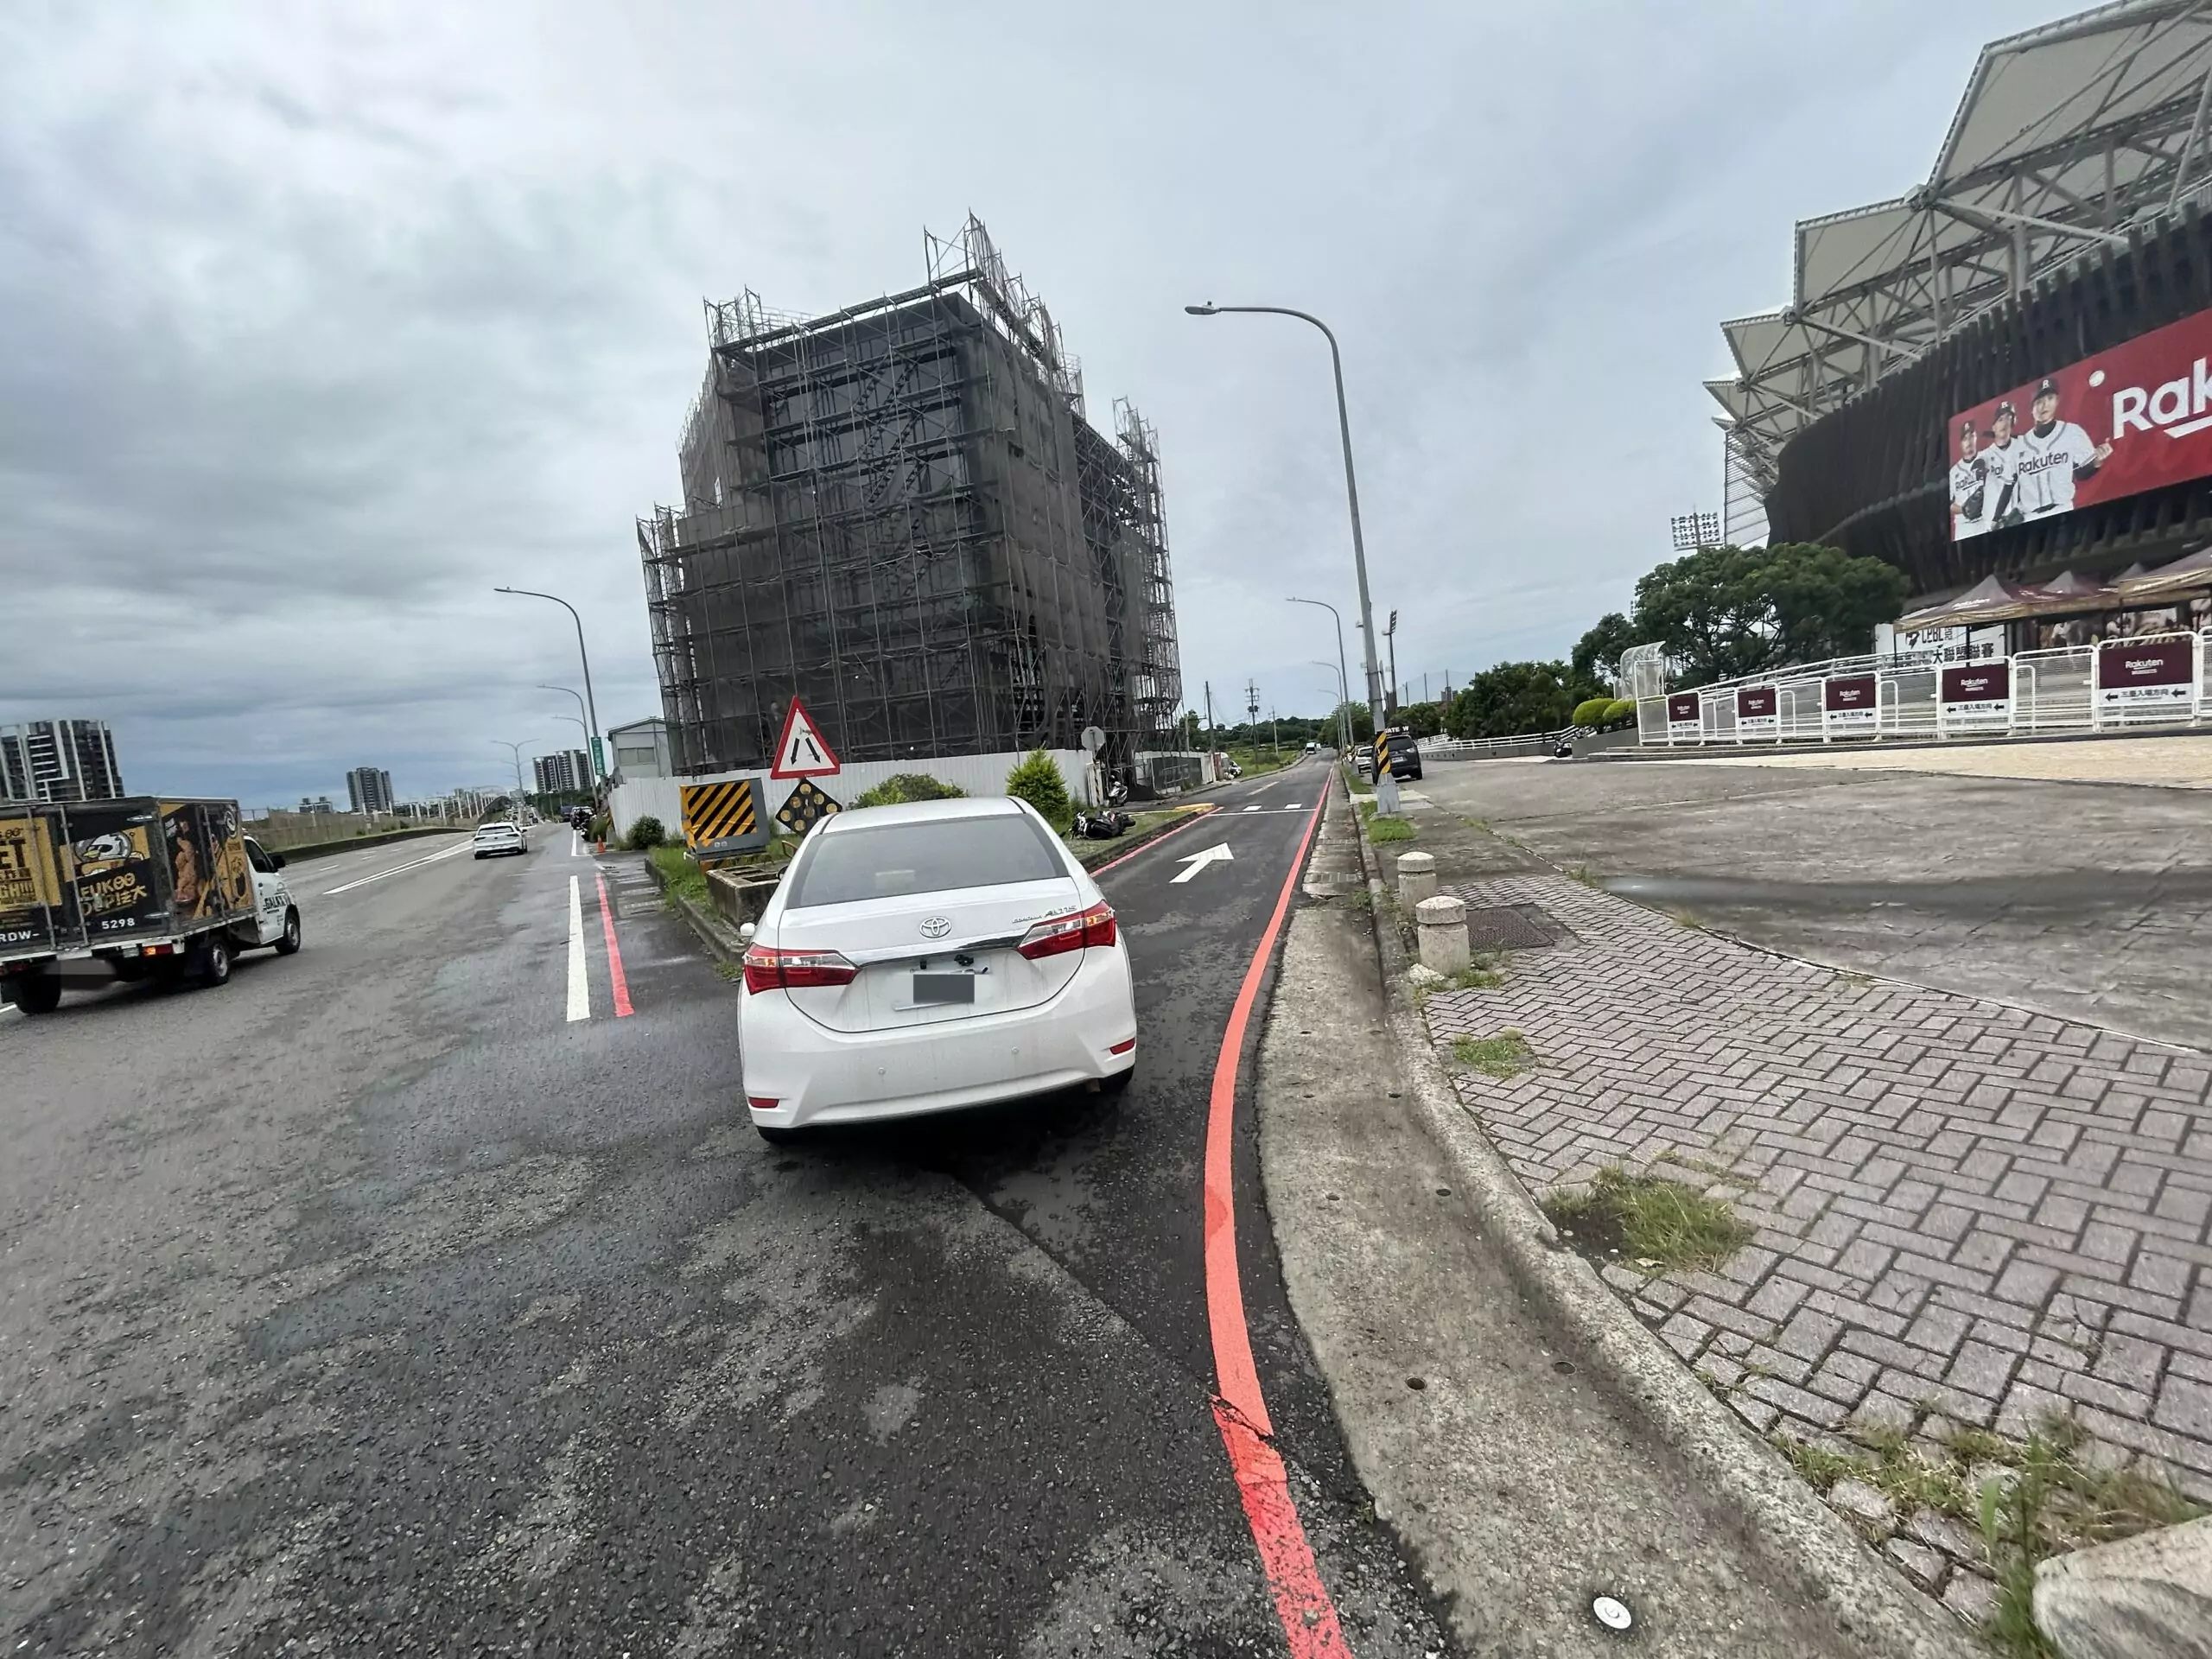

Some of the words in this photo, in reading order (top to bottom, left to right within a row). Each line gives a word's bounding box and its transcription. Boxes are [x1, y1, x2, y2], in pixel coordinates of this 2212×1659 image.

[2018, 451, 2069, 475] Rakuten
[2126, 658, 2164, 671] Rakuten
[1961, 677, 1988, 687] Rakuten
[101, 918, 135, 930] 5298
